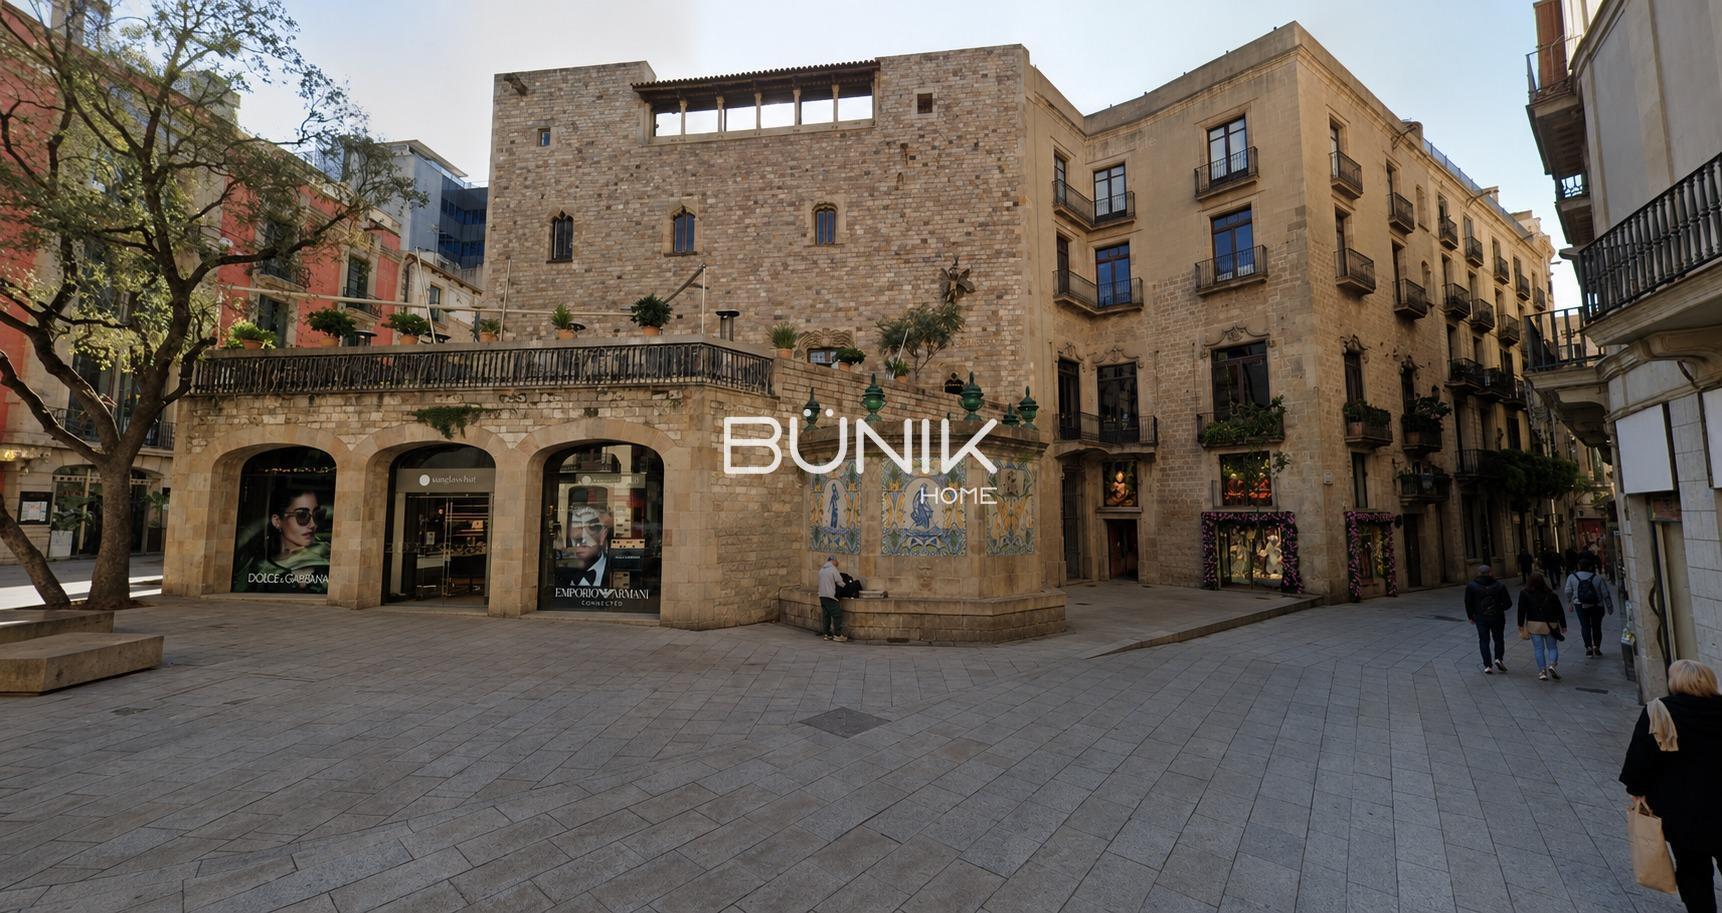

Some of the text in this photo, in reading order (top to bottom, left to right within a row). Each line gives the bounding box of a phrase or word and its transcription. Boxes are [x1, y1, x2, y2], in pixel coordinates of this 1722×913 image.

[247, 573, 279, 583] DOLCE
[285, 573, 329, 584] GABBANA
[555, 587, 649, 600] EMPORIO ARMANI
